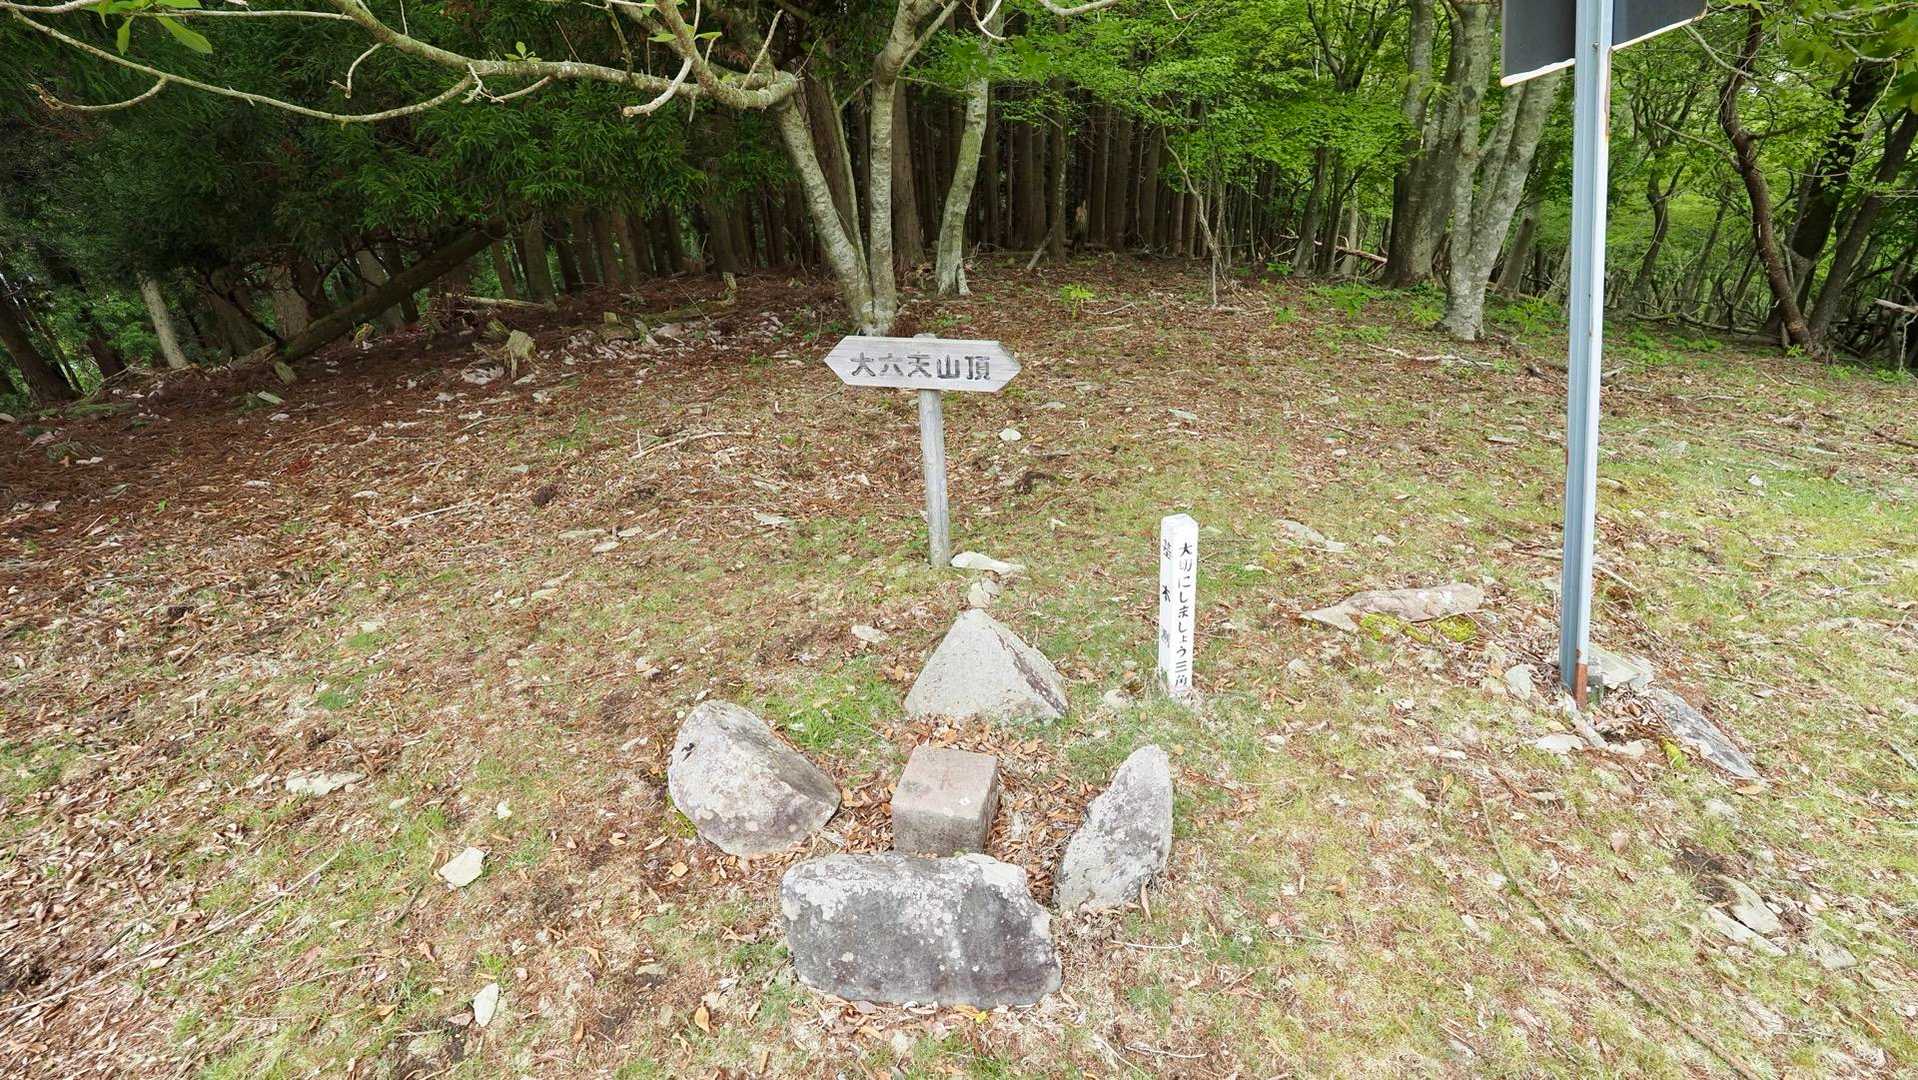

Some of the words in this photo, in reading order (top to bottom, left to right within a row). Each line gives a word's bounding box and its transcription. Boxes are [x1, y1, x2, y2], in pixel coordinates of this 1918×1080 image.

[850, 351, 991, 381] 大六天山頂
